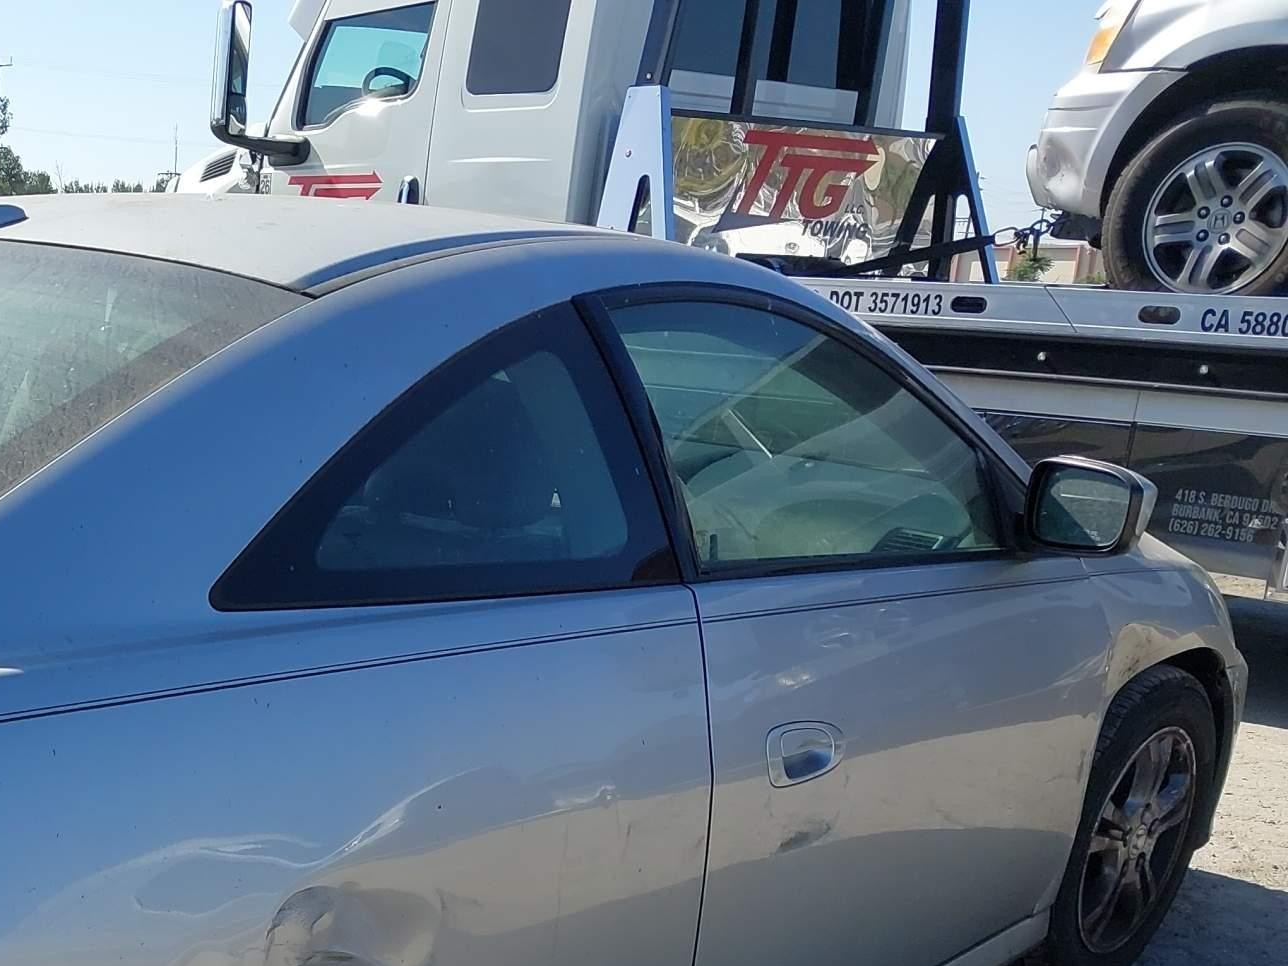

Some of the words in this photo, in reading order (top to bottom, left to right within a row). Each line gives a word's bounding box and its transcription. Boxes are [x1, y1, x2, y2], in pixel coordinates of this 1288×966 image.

[733, 130, 880, 220] TTG
[801, 219, 870, 241] TOWING
[829, 290, 864, 313] DOT
[868, 291, 943, 316] 3571913
[1200, 308, 1230, 333] CA
[1175, 488, 1197, 503] 418
[1172, 503, 1223, 524] BURBANK,
[1225, 511, 1240, 525] CA
[1168, 518, 1199, 536] (626)
